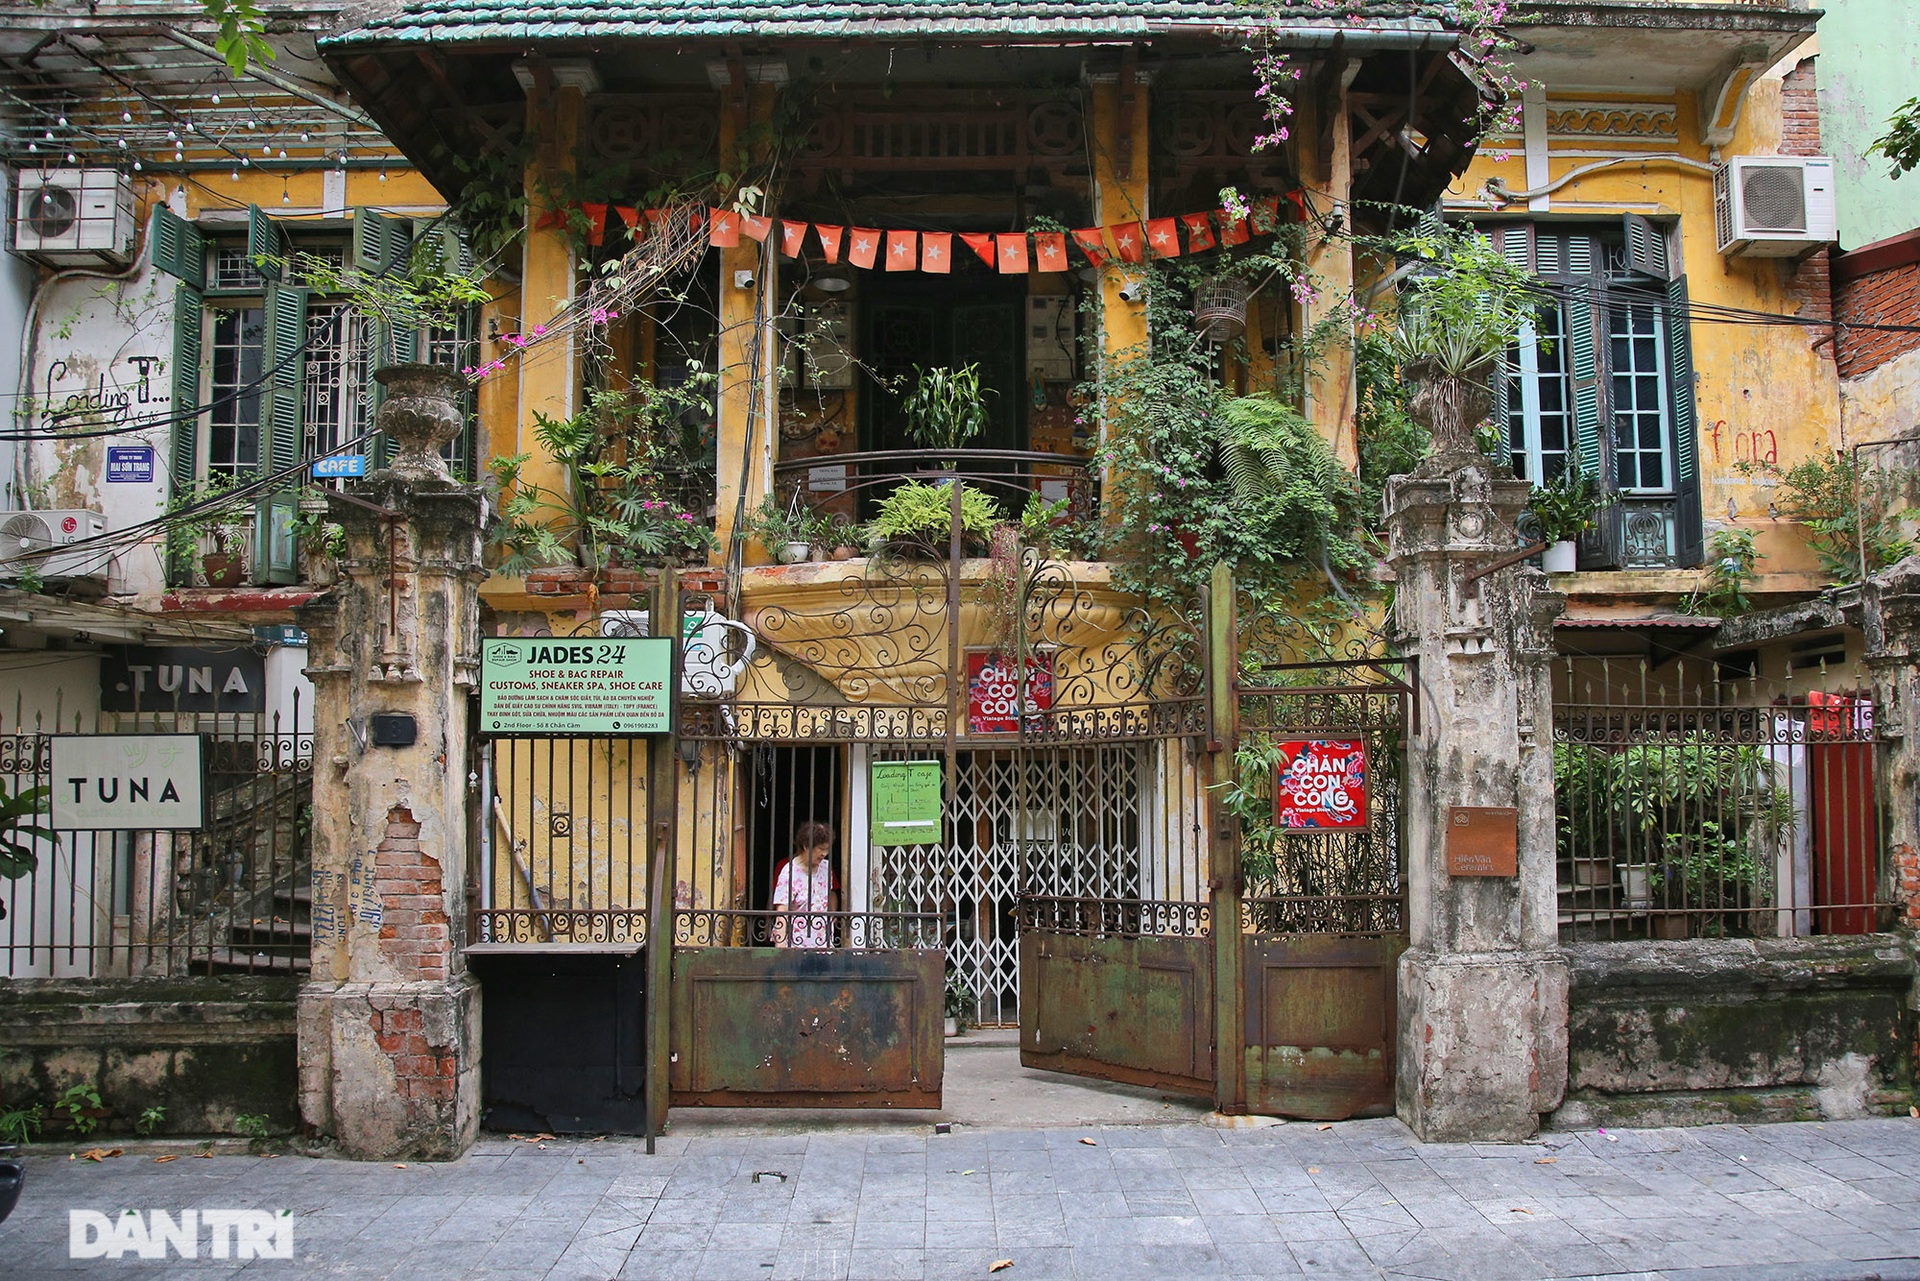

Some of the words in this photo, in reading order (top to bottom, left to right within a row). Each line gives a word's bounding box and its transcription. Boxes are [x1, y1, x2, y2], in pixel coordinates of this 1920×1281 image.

[41, 361, 132, 432] Loading
[317, 456, 358, 473] CAFÉ
[62, 536, 75, 544] LG
[527, 646, 594, 664] JADES
[596, 645, 626, 664] 24
[529, 670, 555, 678] SHOE
[558, 670, 565, 678] &
[568, 670, 587, 678] BAG
[591, 670, 624, 678] REPAIR
[489, 681, 539, 691] CUSTOMS,
[541, 682, 584, 690] SNEAKER
[587, 682, 607, 691] SPA,
[609, 682, 636, 690] SHOE
[638, 682, 663, 690] CARE
[124, 744, 184, 768] ツナ
[1292, 754, 1346, 773] CHĂN
[1301, 774, 1340, 790] CON
[1294, 788, 1354, 811] CÔNG
[1454, 863, 1494, 871] Ceramics
